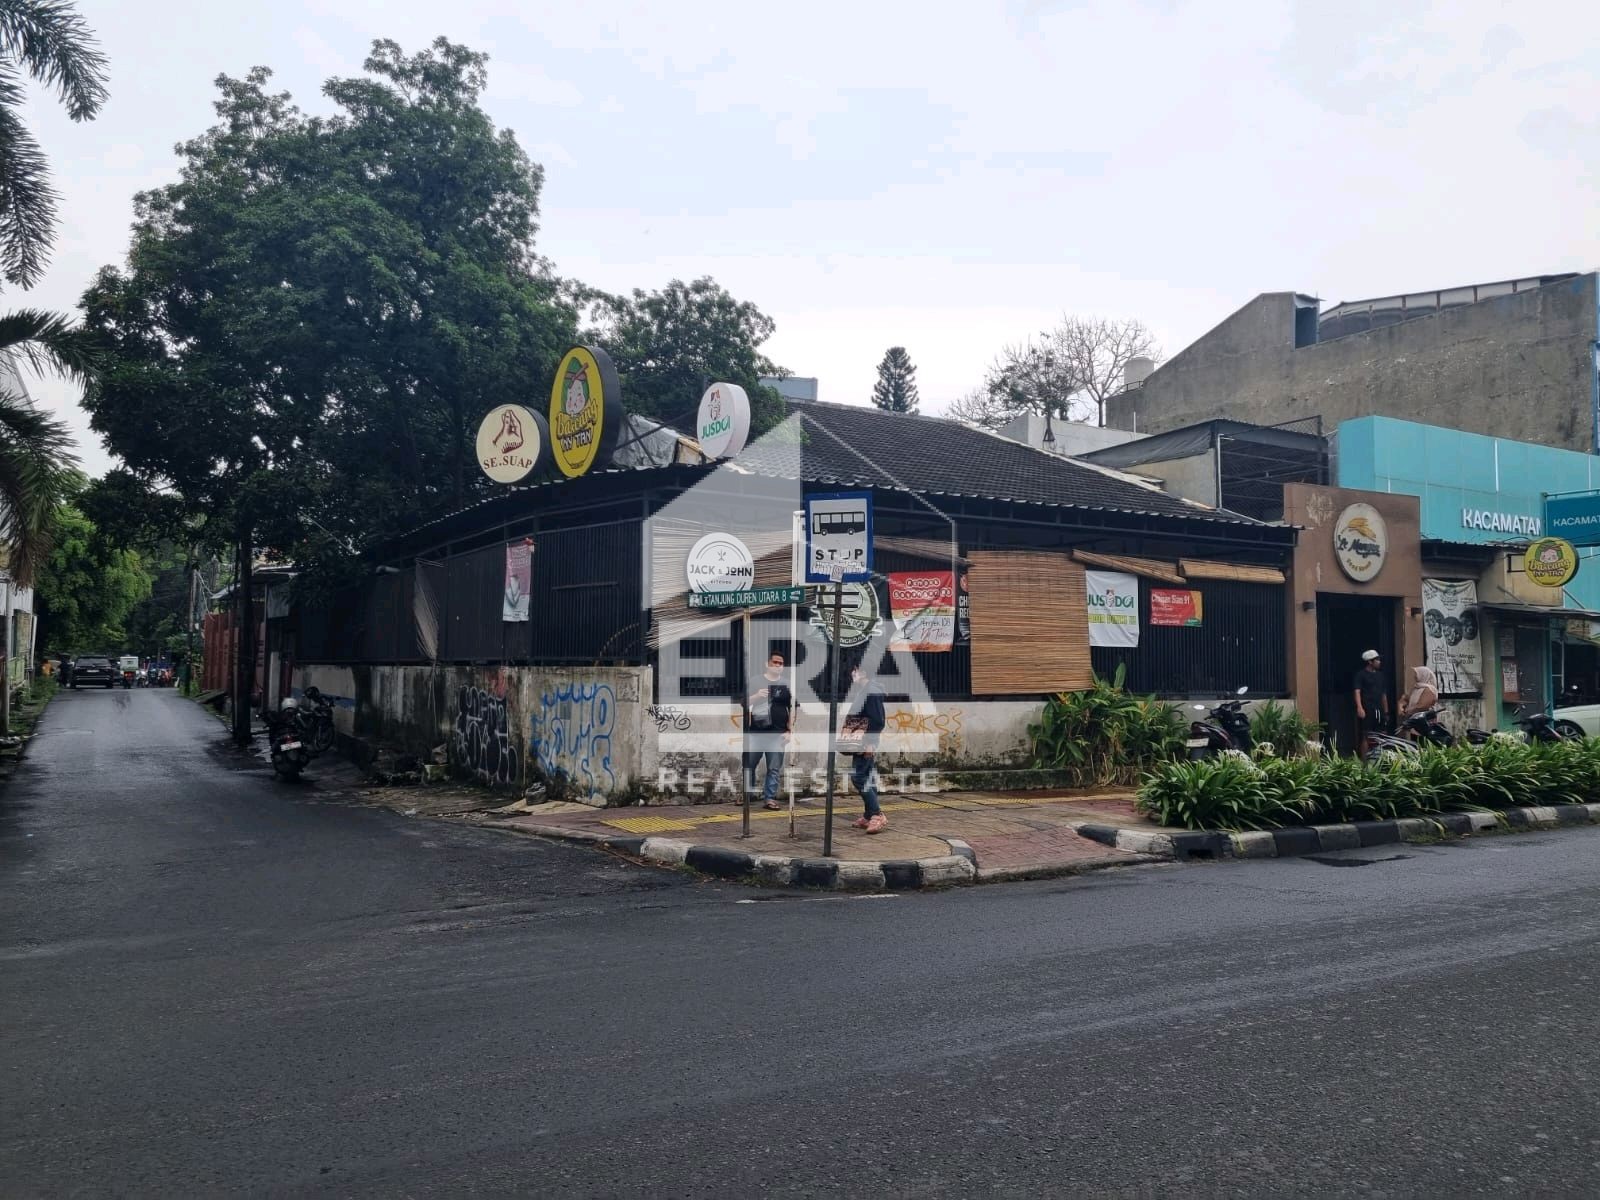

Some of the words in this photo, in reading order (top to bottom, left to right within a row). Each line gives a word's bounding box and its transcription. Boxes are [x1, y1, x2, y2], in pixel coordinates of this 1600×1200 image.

[689, 564, 716, 575] JACK
[725, 566, 752, 577] JOHN
[707, 593, 735, 606] TANJUNG
[736, 591, 757, 604] DUREN
[758, 590, 779, 602] UTARA
